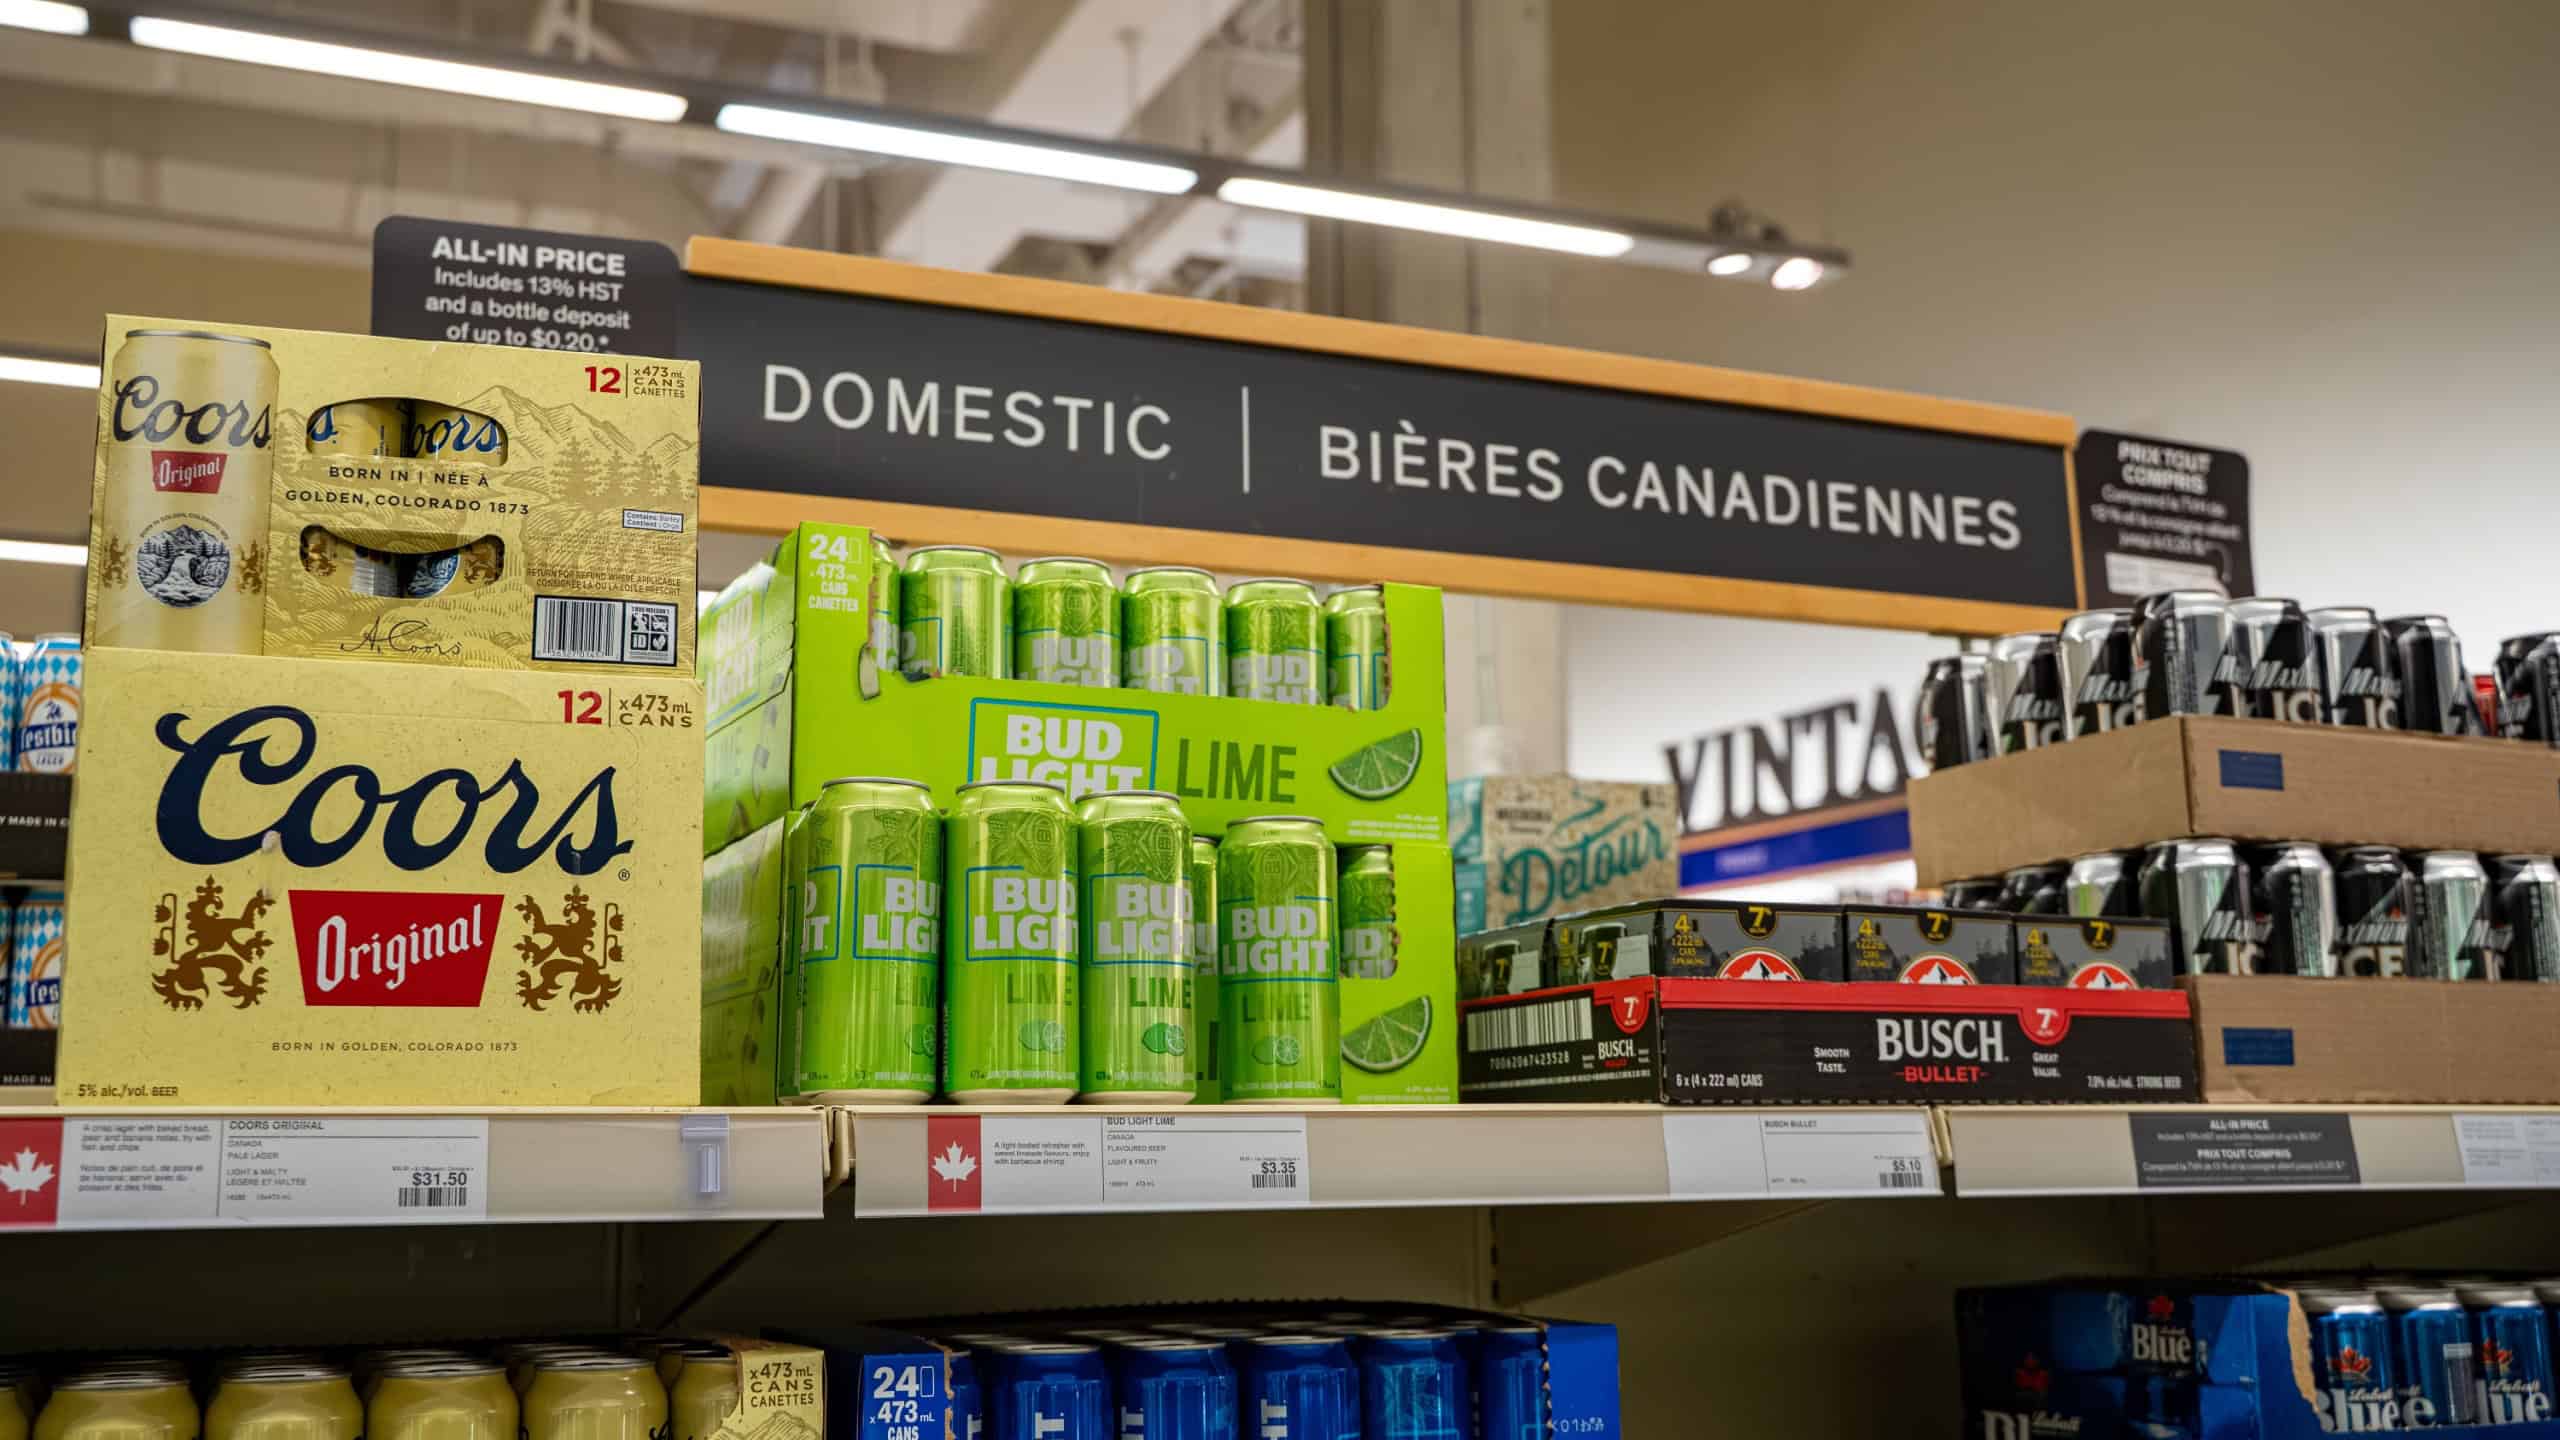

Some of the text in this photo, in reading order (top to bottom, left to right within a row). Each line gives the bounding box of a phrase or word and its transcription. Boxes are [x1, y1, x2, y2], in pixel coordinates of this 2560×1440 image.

[432, 236, 626, 277] ALL-IN PRICE
[435, 267, 624, 302] Includes 13% HST
[425, 296, 631, 330] and a bottle deposit
[446, 323, 470, 341] of
[473, 327, 500, 345] up
[505, 329, 526, 346] to
[585, 366, 620, 394] 12
[633, 386, 685, 399] CANETTES
[634, 377, 685, 389] CANS
[113, 375, 273, 448] Coors
[764, 364, 1171, 460] DOMESTIC
[159, 457, 220, 488] Original
[329, 466, 381, 480] BORN
[391, 470, 409, 482] IN
[434, 470, 470, 486] NÉE
[1320, 419, 1564, 501] BIÈRES
[1588, 456, 2021, 551] CANADIENNES
[286, 490, 530, 516] GOLDEN, COLORADO 1873
[809, 533, 849, 562] 24
[821, 581, 848, 596] CANS
[1032, 637, 1111, 669] BUD
[1231, 655, 1310, 686] BUD
[558, 690, 692, 725] 12 x473 mL
[620, 713, 692, 728] CANS
[1006, 714, 1123, 761] BUD
[980, 738, 1297, 804] LIGHT LIME
[1660, 685, 1910, 834] VINTA
[156, 705, 635, 876] Coors
[8, 815, 57, 828] MADE IN
[1498, 816, 1665, 924] Detour
[992, 877, 1077, 914] BUD
[1116, 882, 1193, 921] BUD
[974, 914, 1079, 955] LIGH
[1231, 905, 1317, 941] BUD
[1674, 913, 1691, 932] 4
[1858, 918, 1873, 935] 4
[316, 903, 484, 993] Original
[1097, 919, 1195, 957] LIGH
[1222, 939, 1330, 976] LIGHT
[1007, 973, 1073, 1007] LIME
[1129, 976, 1192, 1009] LIME
[1243, 994, 1311, 1023] LIME
[271, 1041, 518, 1053] BORN IN GOLDEN, COLORADO 1873
[1598, 1039, 1636, 1060] BUSCH
[1876, 1018, 2005, 1063] BUSCH
[1676, 1073, 1682, 1087] 6
[1684, 1077, 1690, 1087] x
[1691, 1073, 1700, 1088] (4
[1701, 1077, 1707, 1087] x
[1708, 1073, 1725, 1087] 222
[1740, 1073, 1763, 1088] CANS
[1904, 1065, 1980, 1083] BULLET
[78, 1083, 97, 1096] 5%
[273, 1120, 325, 1130] ORIGINAL
[1107, 1116, 1176, 1126] BUD LIGHT LIME
[412, 1171, 467, 1186] $31.50
[1262, 1161, 1296, 1174] $3.35
[1892, 1160, 1921, 1172] $5.10
[2131, 1322, 2193, 1364] Blue
[750, 1362, 813, 1380] x473 mL
[750, 1379, 814, 1393] CANS
[873, 1366, 919, 1399] 24
[750, 1393, 814, 1408] CANETTES
[2476, 1379, 2550, 1425] lue
[887, 1425, 919, 1440] CANS
[920, 1413, 936, 1423] mL
